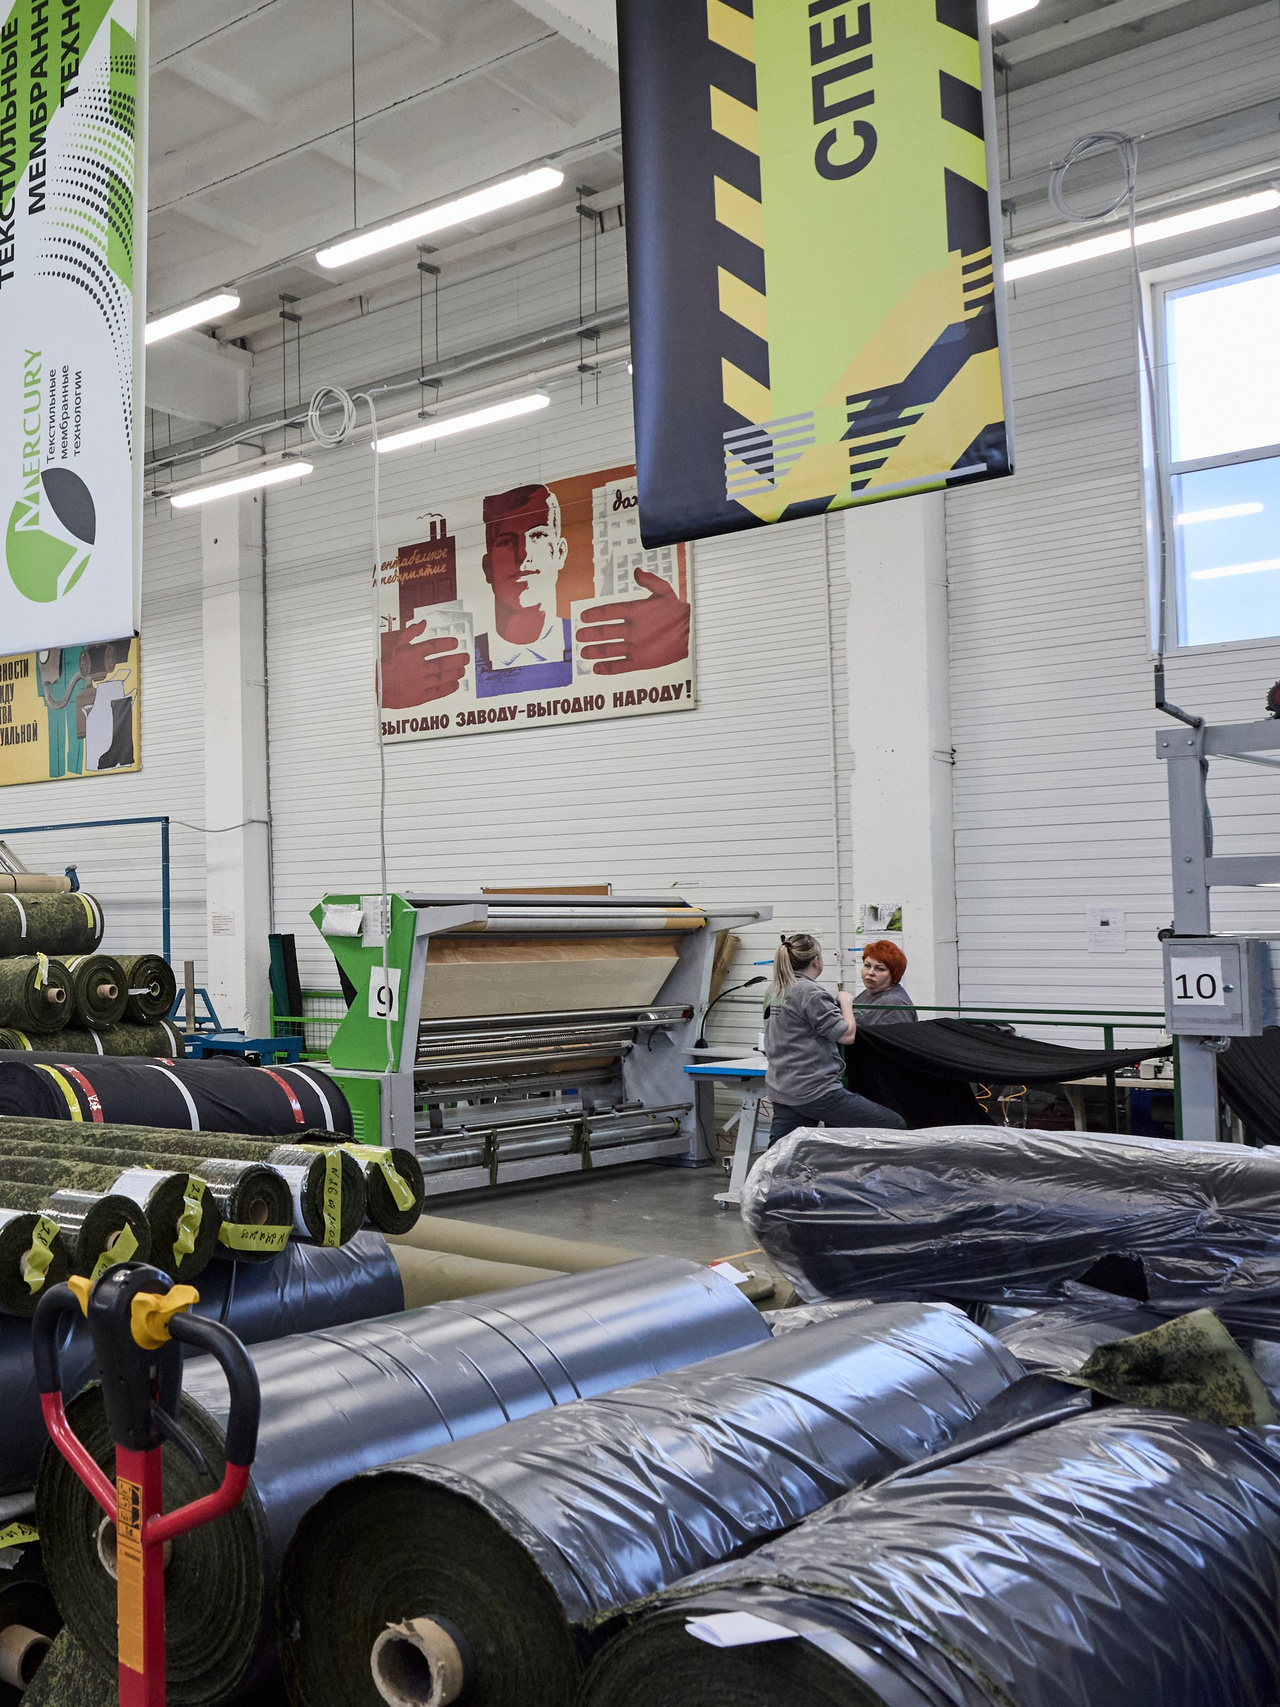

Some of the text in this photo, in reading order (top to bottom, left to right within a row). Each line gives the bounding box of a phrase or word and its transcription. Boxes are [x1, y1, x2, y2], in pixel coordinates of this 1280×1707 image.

[28, 0, 49, 215] МЕМБРАНН
[808, 0, 878, 181] СПЕ
[15, 348, 42, 532] MERCURY
[46, 369, 57, 464] Текстильные
[60, 365, 69, 460] мембранные
[74, 370, 82, 457] технологии
[613, 679, 692, 708] НАРОДУ!
[377, 985, 394, 1016] 9
[1175, 973, 1217, 999] 10
